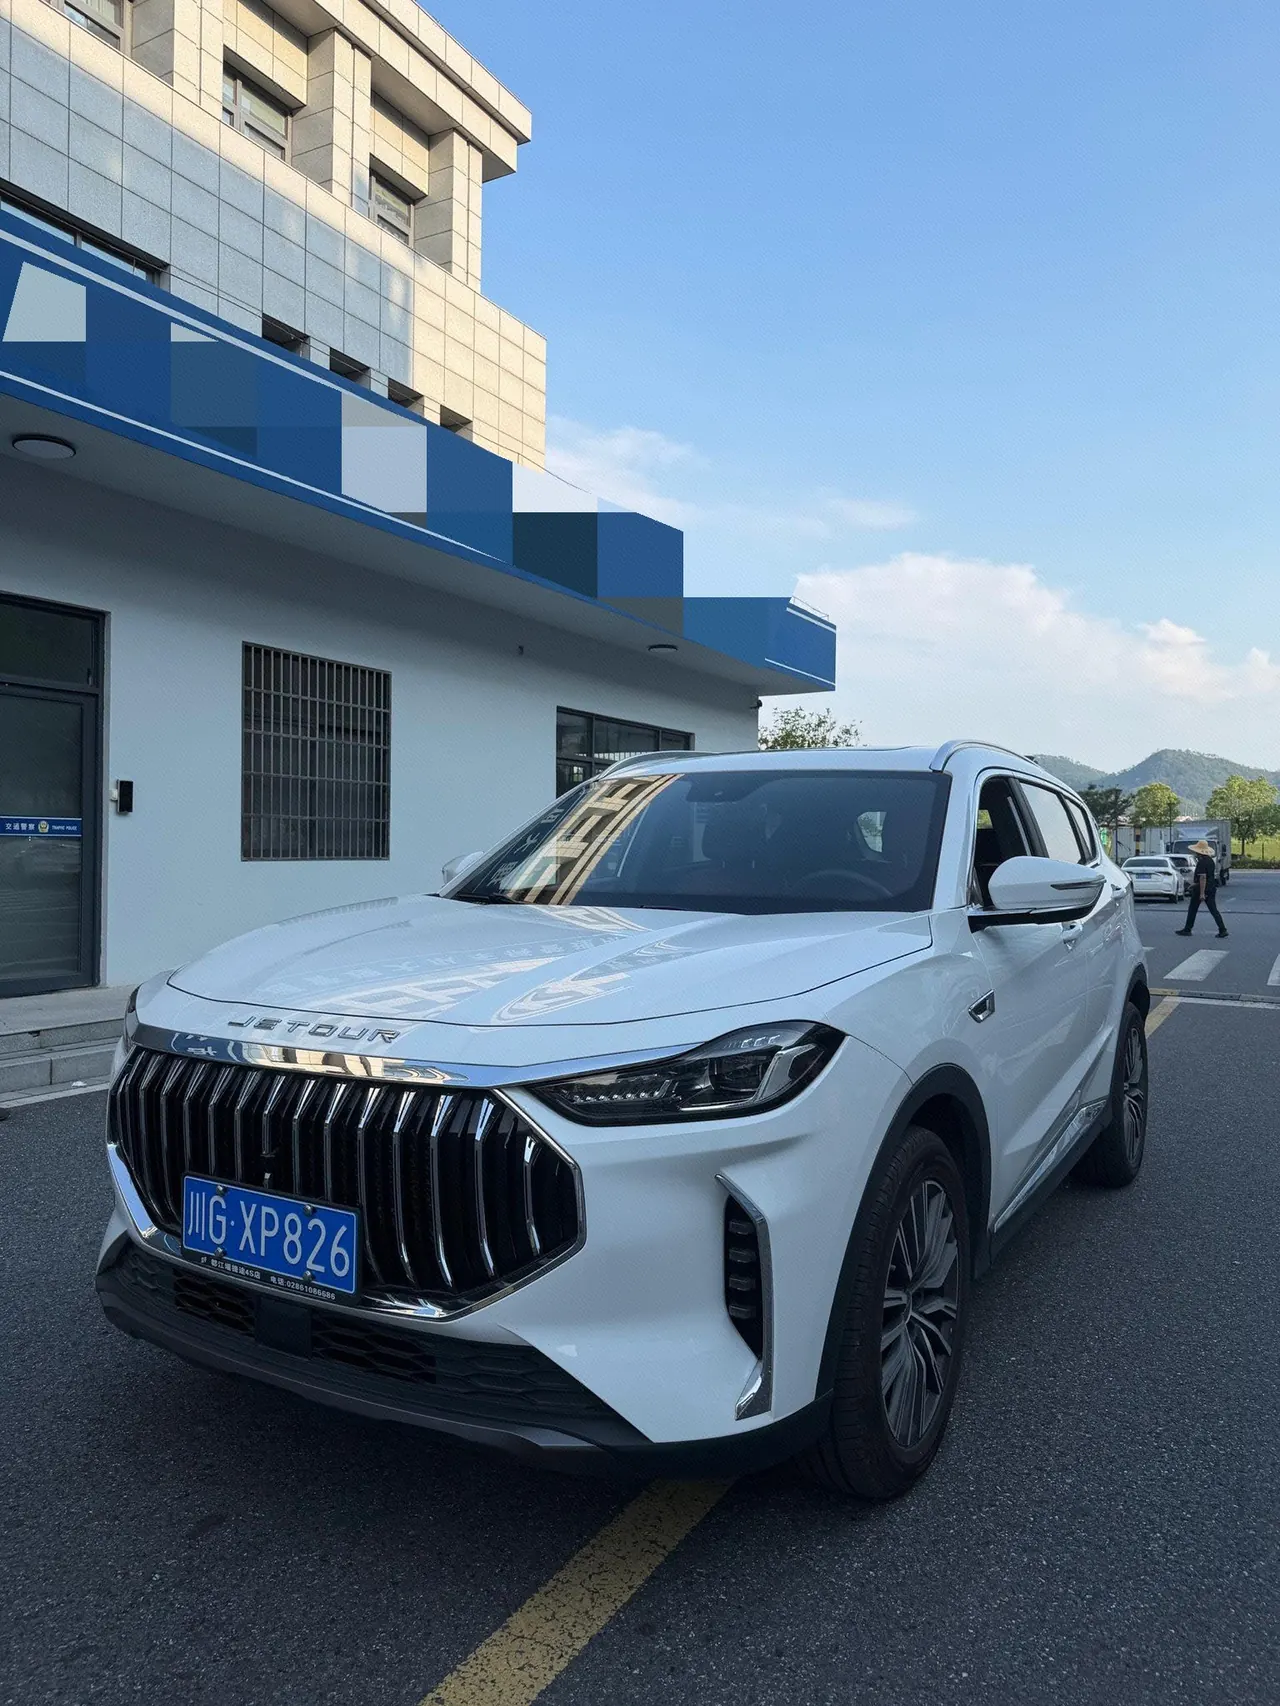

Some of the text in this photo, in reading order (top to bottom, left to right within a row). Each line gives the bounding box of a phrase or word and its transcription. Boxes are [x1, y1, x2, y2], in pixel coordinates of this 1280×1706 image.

[5, 822, 35, 831] 交通警察
[228, 1015, 401, 1044] JETOUR
